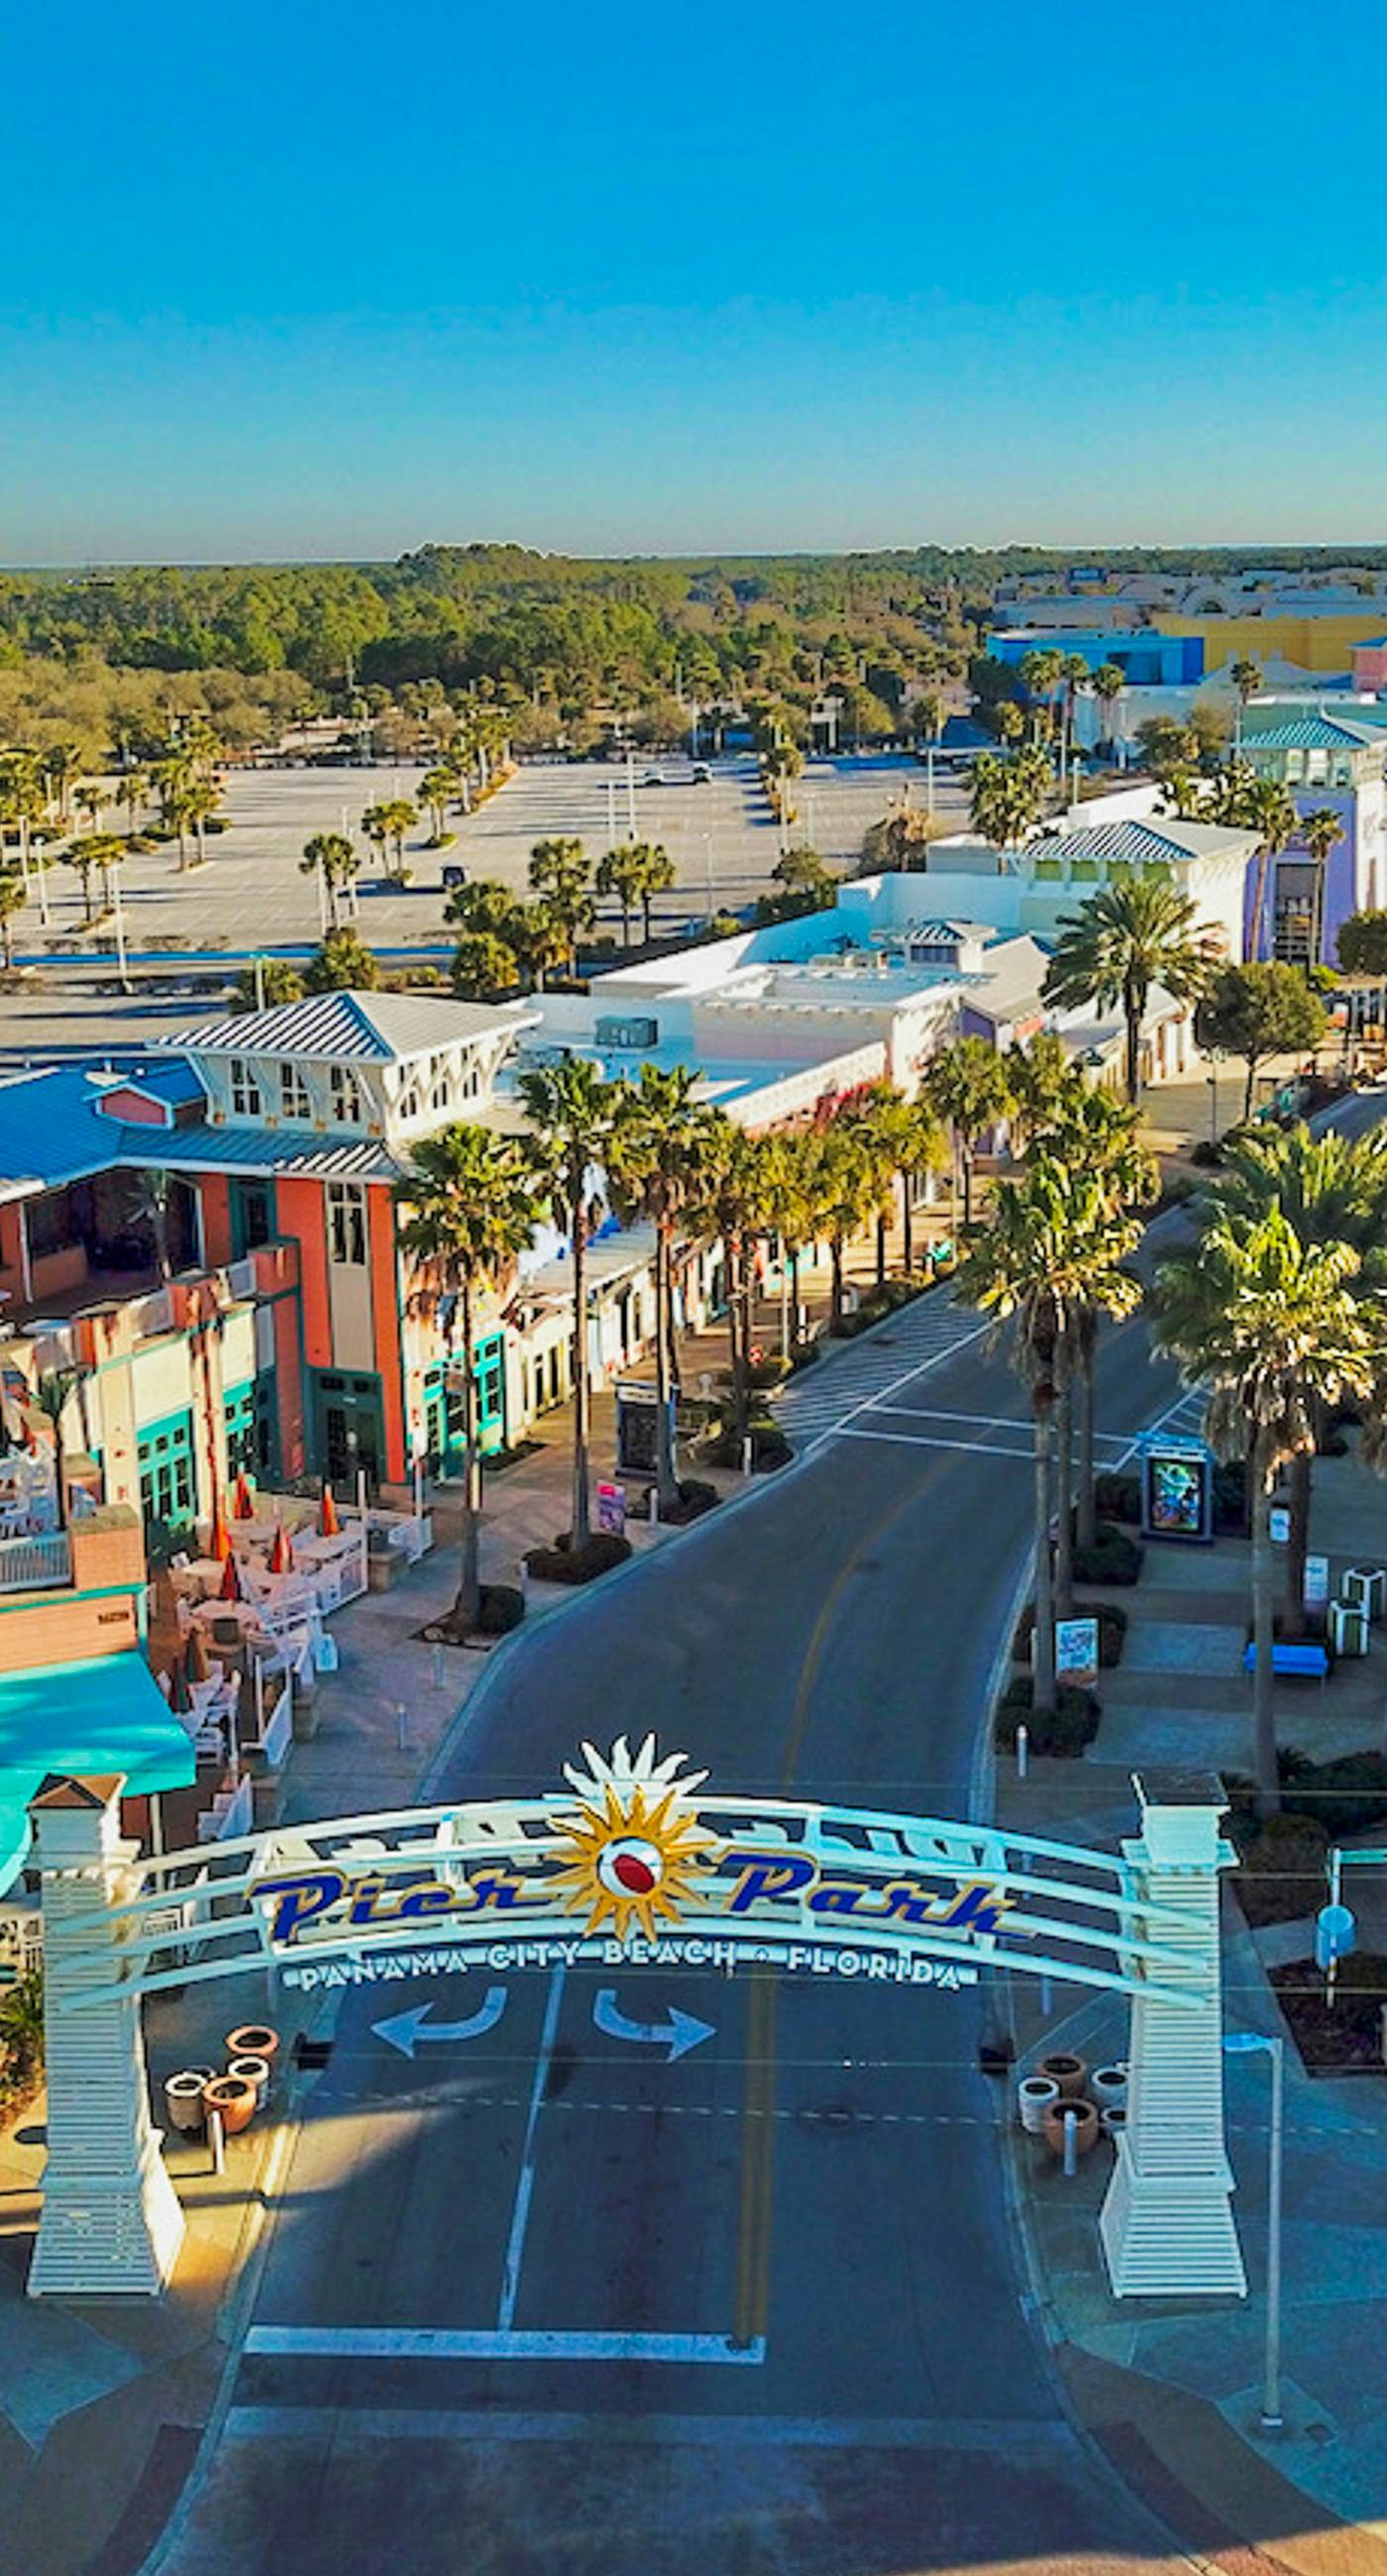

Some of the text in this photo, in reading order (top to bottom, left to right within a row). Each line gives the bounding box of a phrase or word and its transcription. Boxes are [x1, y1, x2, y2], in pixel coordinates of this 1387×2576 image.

[246, 1846, 1038, 1946] Pier Park
[299, 1939, 960, 1990] PANAMA CITY BEACH FLORIDA
